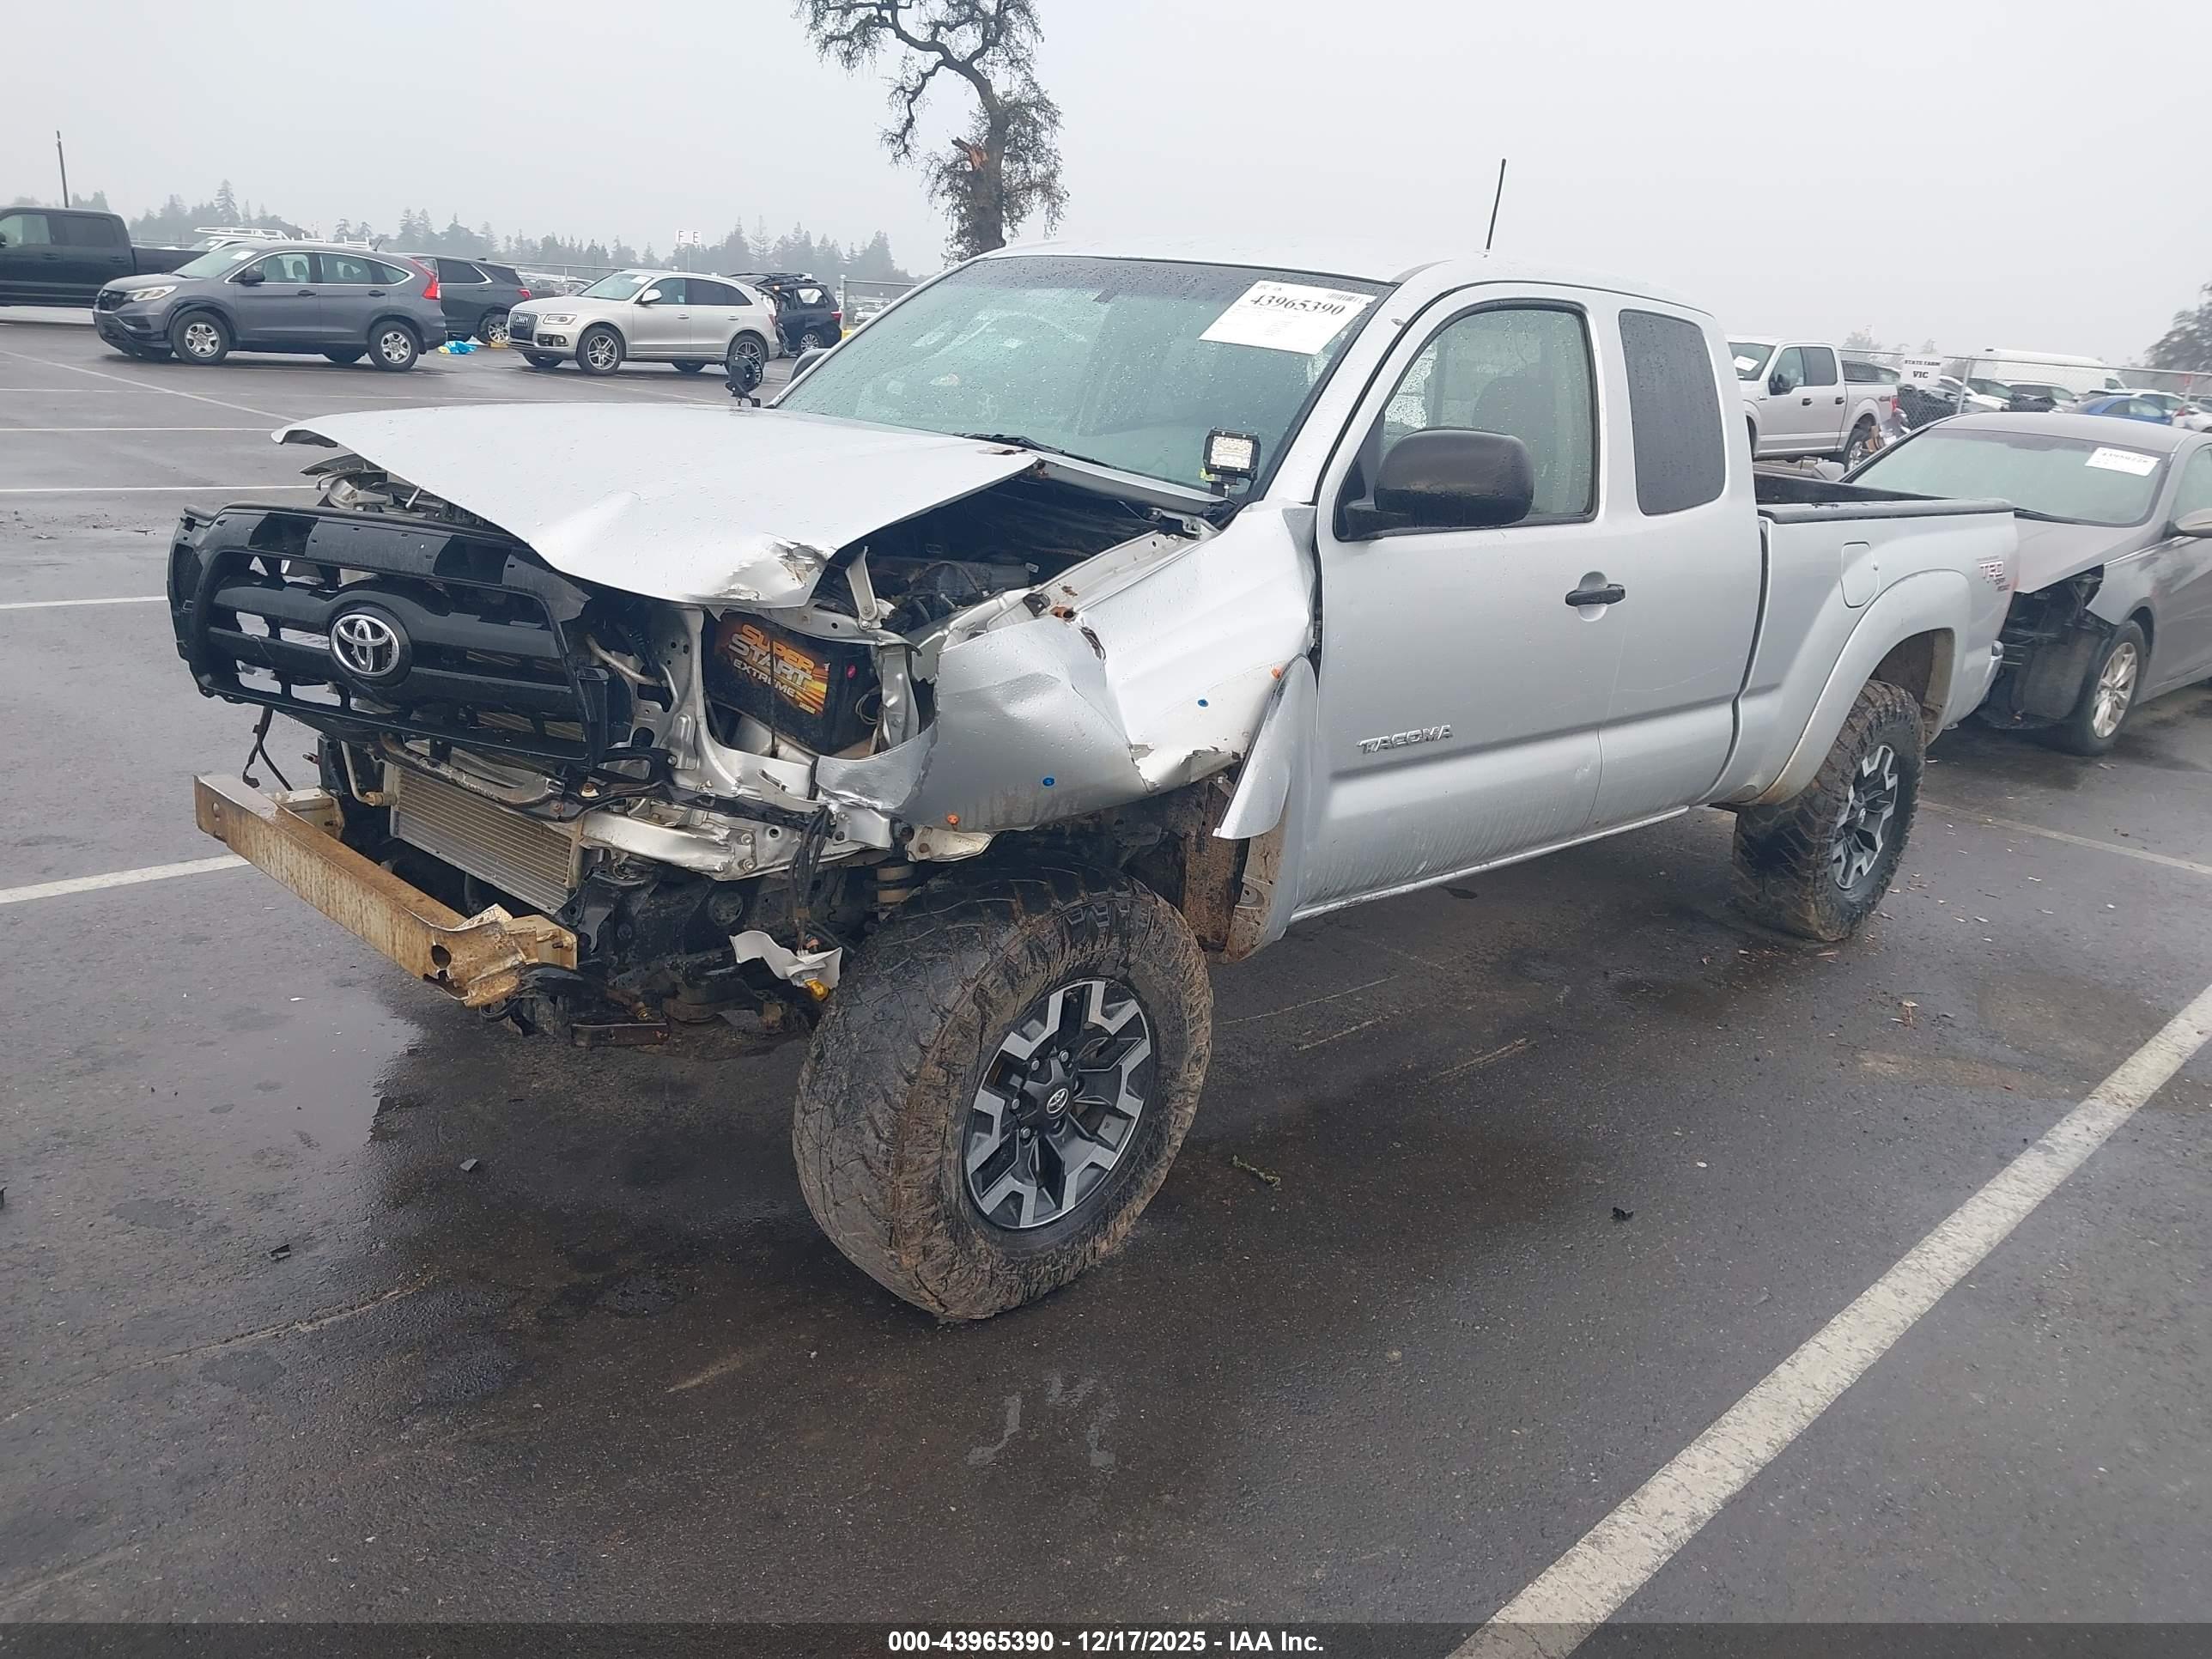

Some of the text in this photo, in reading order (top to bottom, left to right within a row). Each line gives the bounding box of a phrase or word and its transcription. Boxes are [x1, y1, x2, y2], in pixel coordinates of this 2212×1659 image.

[1250, 294, 1346, 315] 43965390
[1912, 370, 1929, 379] VIC
[728, 634, 813, 689] START
[742, 623, 815, 676] SUPER
[1357, 724, 1453, 754] TACOMA
